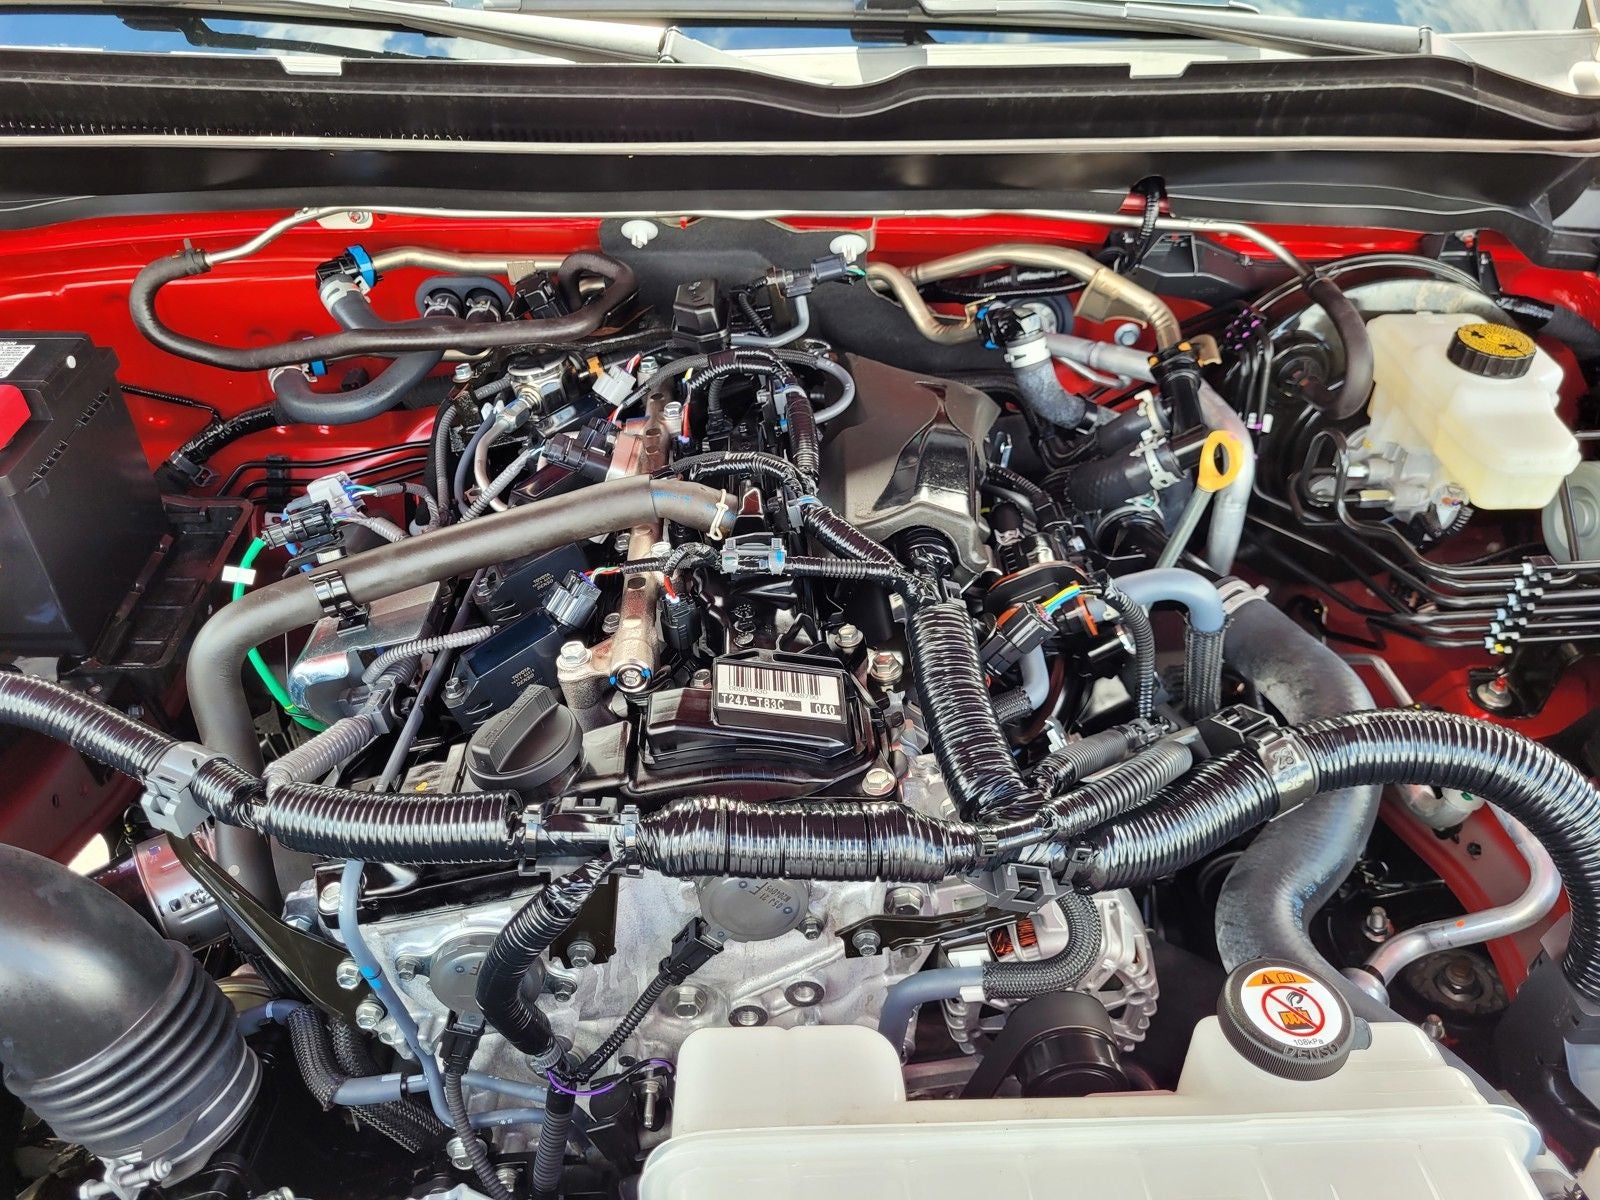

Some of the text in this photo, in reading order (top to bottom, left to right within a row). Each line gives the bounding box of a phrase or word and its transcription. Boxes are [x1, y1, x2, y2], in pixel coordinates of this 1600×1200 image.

[532, 572, 551, 584] TOYOTA
[536, 579, 554, 590] DENSO
[511, 666, 531, 680] TOYOTA
[516, 673, 535, 687] DENSO
[721, 693, 786, 710] T24A-T83C
[815, 703, 836, 716] 040
[1293, 1037, 1325, 1047] 108kPa
[1282, 1042, 1341, 1060] DENSO
